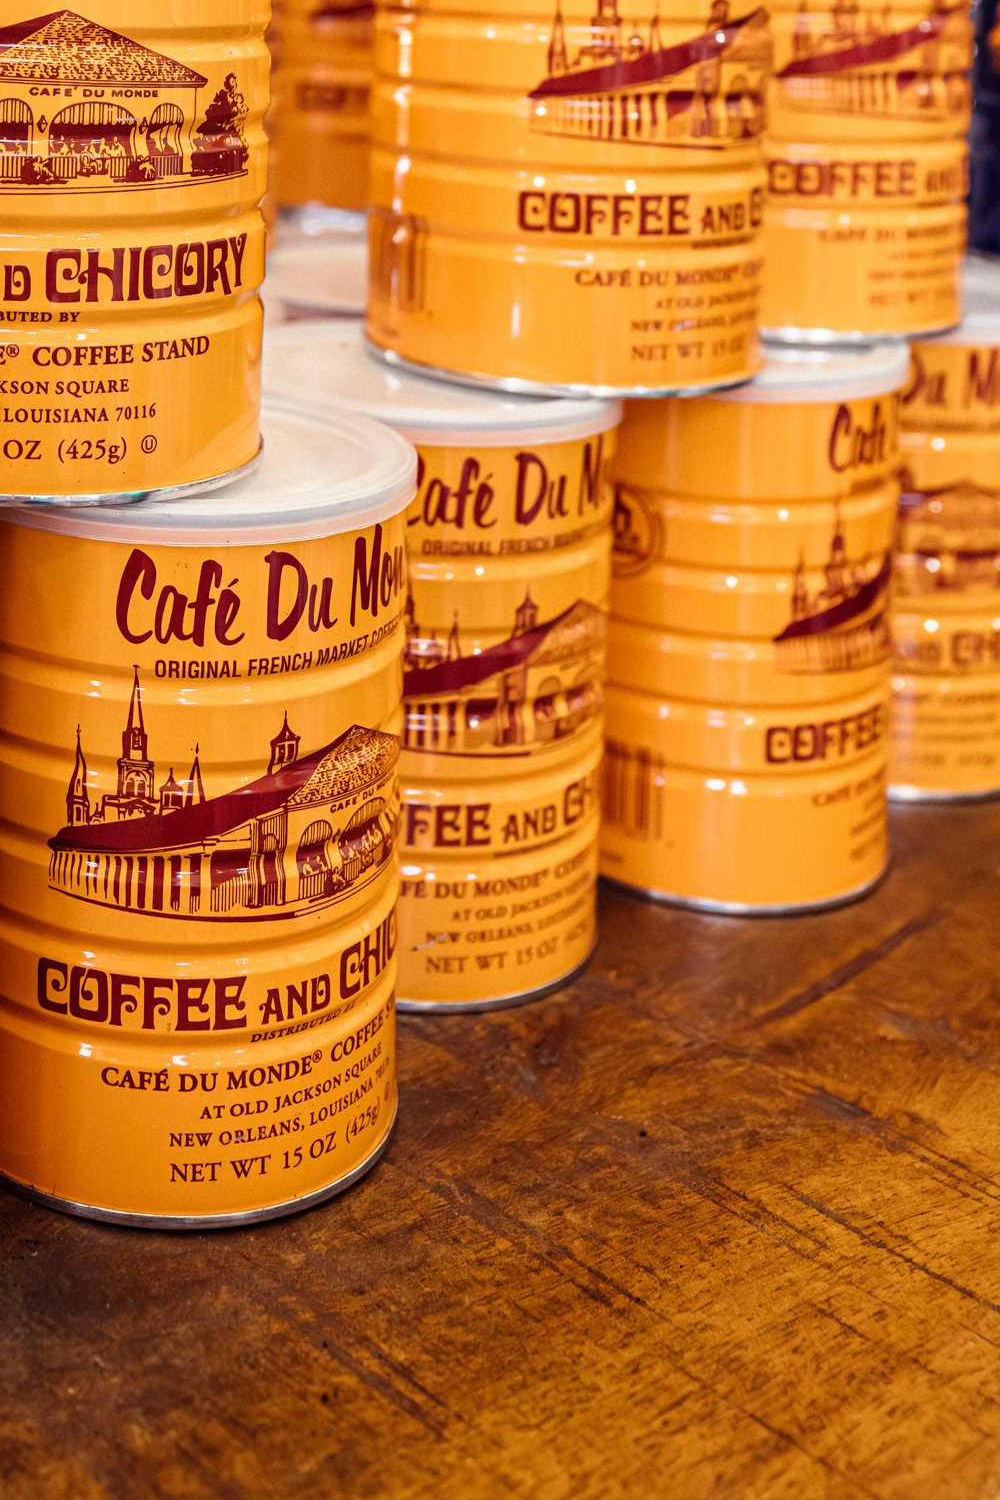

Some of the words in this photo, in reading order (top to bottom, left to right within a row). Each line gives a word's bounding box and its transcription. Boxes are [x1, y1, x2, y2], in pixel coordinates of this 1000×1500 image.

[84, 87, 106, 99] DU
[111, 88, 160, 99] MONDE
[768, 160, 917, 197] COFFEE
[518, 191, 691, 236] COFFEE
[701, 201, 745, 235] AND
[45, 233, 248, 303] CHICORY
[639, 270, 671, 288] DU
[59, 311, 81, 324] BY
[32, 343, 134, 367] COFFEE
[141, 335, 211, 362] STAND
[55, 378, 130, 397] SQUARE
[3, 407, 110, 423] LOUISIANA
[115, 403, 157, 422] 70116
[3, 439, 42, 460] OZ
[57, 436, 127, 465] (425g)
[515, 452, 568, 525] Du
[115, 549, 245, 647] Café
[264, 550, 338, 642] Du
[155, 660, 241, 679] ORIGINAL
[247, 651, 313, 677] FRENCH
[316, 635, 369, 667] MARKET
[362, 787, 374, 800] DU
[401, 803, 492, 847] FEE
[502, 805, 557, 844] AND
[435, 882, 468, 899] DU
[426, 956, 467, 974] NET
[475, 952, 508, 970] WT
[38, 957, 248, 1031] COFFEE
[259, 974, 330, 1025] AND
[250, 1008, 341, 1043] DISTRIBUTED
[100, 1067, 170, 1093] CAFÉ
[178, 1073, 219, 1093] DU
[331, 1012, 385, 1062] COFFEE
[200, 1106, 225, 1120] AT
[230, 1100, 269, 1118] OLD
[273, 1074, 342, 1113] JACKSON
[344, 1042, 382, 1082] SQUARE
[170, 1132, 213, 1148] NEW
[219, 1117, 305, 1145] ORLEANS,
[310, 1077, 373, 1126] LOUISIANA
[170, 1163, 222, 1183] NET
[230, 1155, 271, 1180] WT
[282, 1146, 303, 1170] 15
[309, 1131, 337, 1159] OZ
[345, 1096, 381, 1144] (425g)
